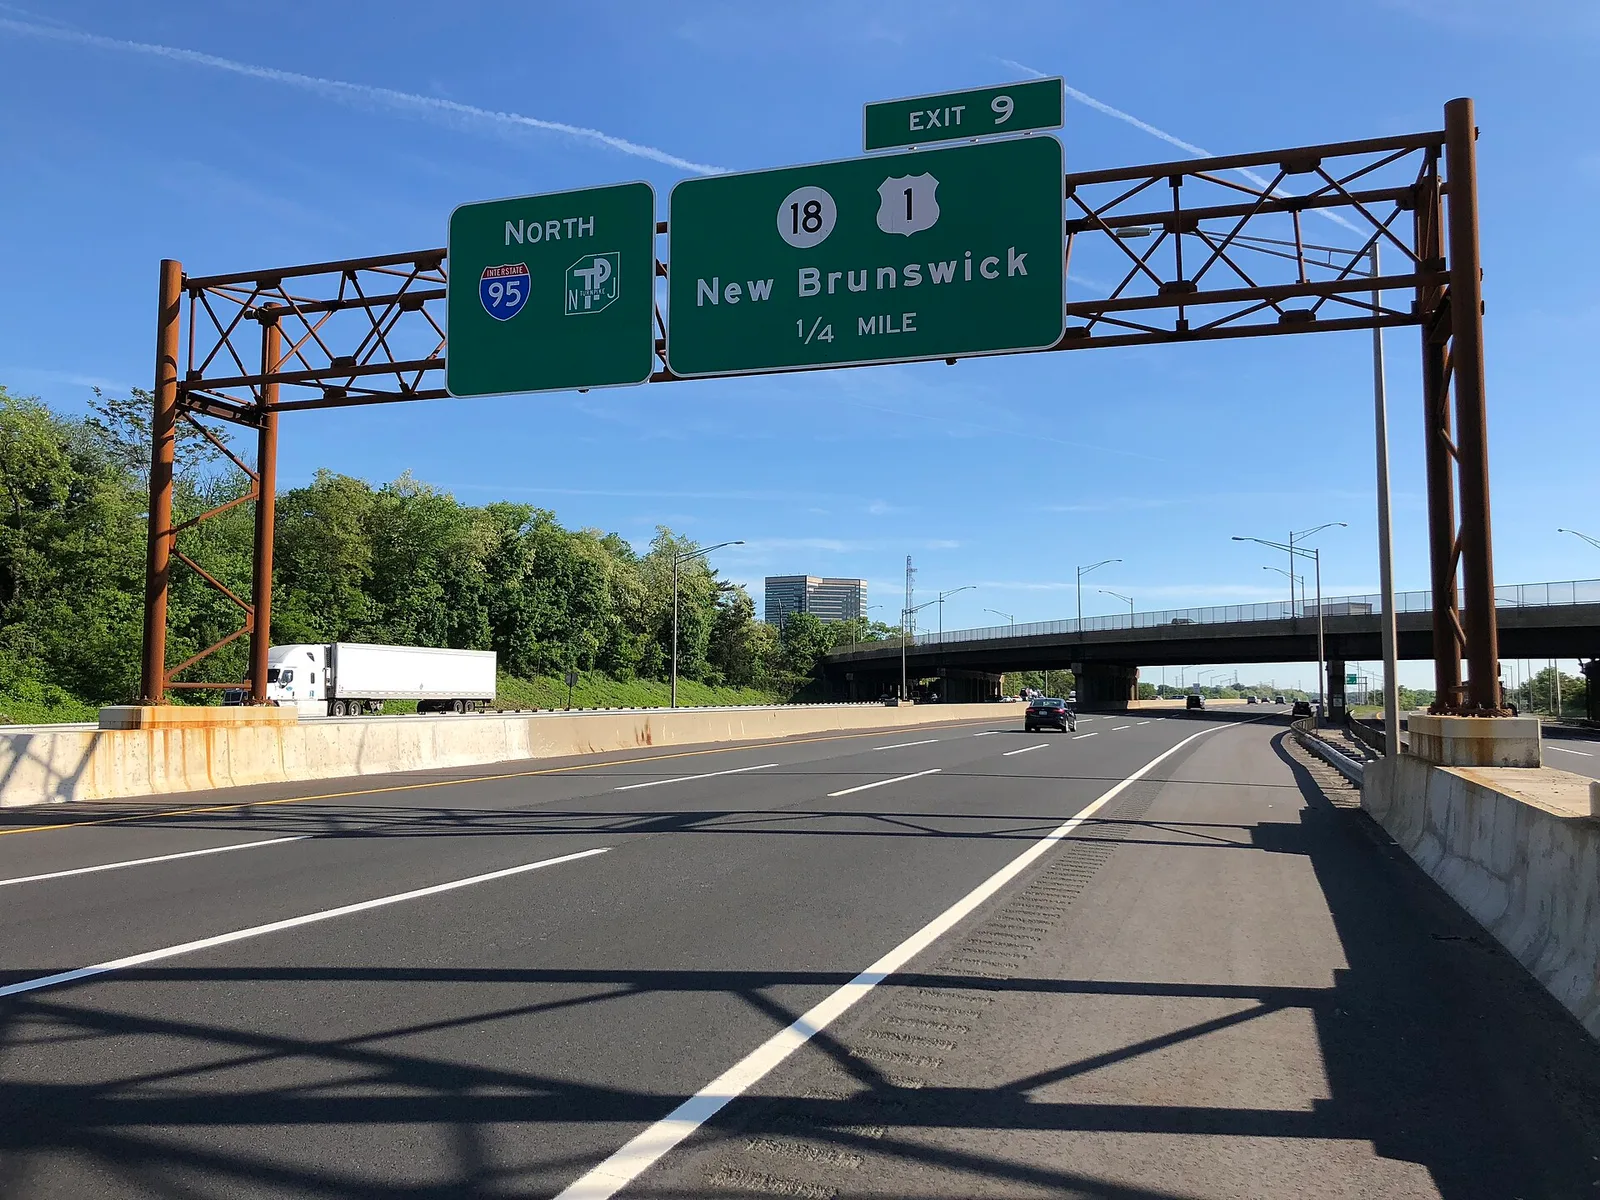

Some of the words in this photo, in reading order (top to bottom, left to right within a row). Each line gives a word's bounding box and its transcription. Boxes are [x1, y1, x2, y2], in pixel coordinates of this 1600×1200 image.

[909, 105, 966, 132] EXIT
[990, 95, 1014, 125] 9
[789, 199, 823, 235] 18
[903, 187, 914, 222] 1
[486, 265, 524, 278] INTERSTATE
[696, 276, 775, 307] New
[798, 246, 1029, 298] Brunswick
[488, 280, 522, 308] 95
[796, 315, 835, 345] 1/4
[857, 312, 917, 336] MILE
